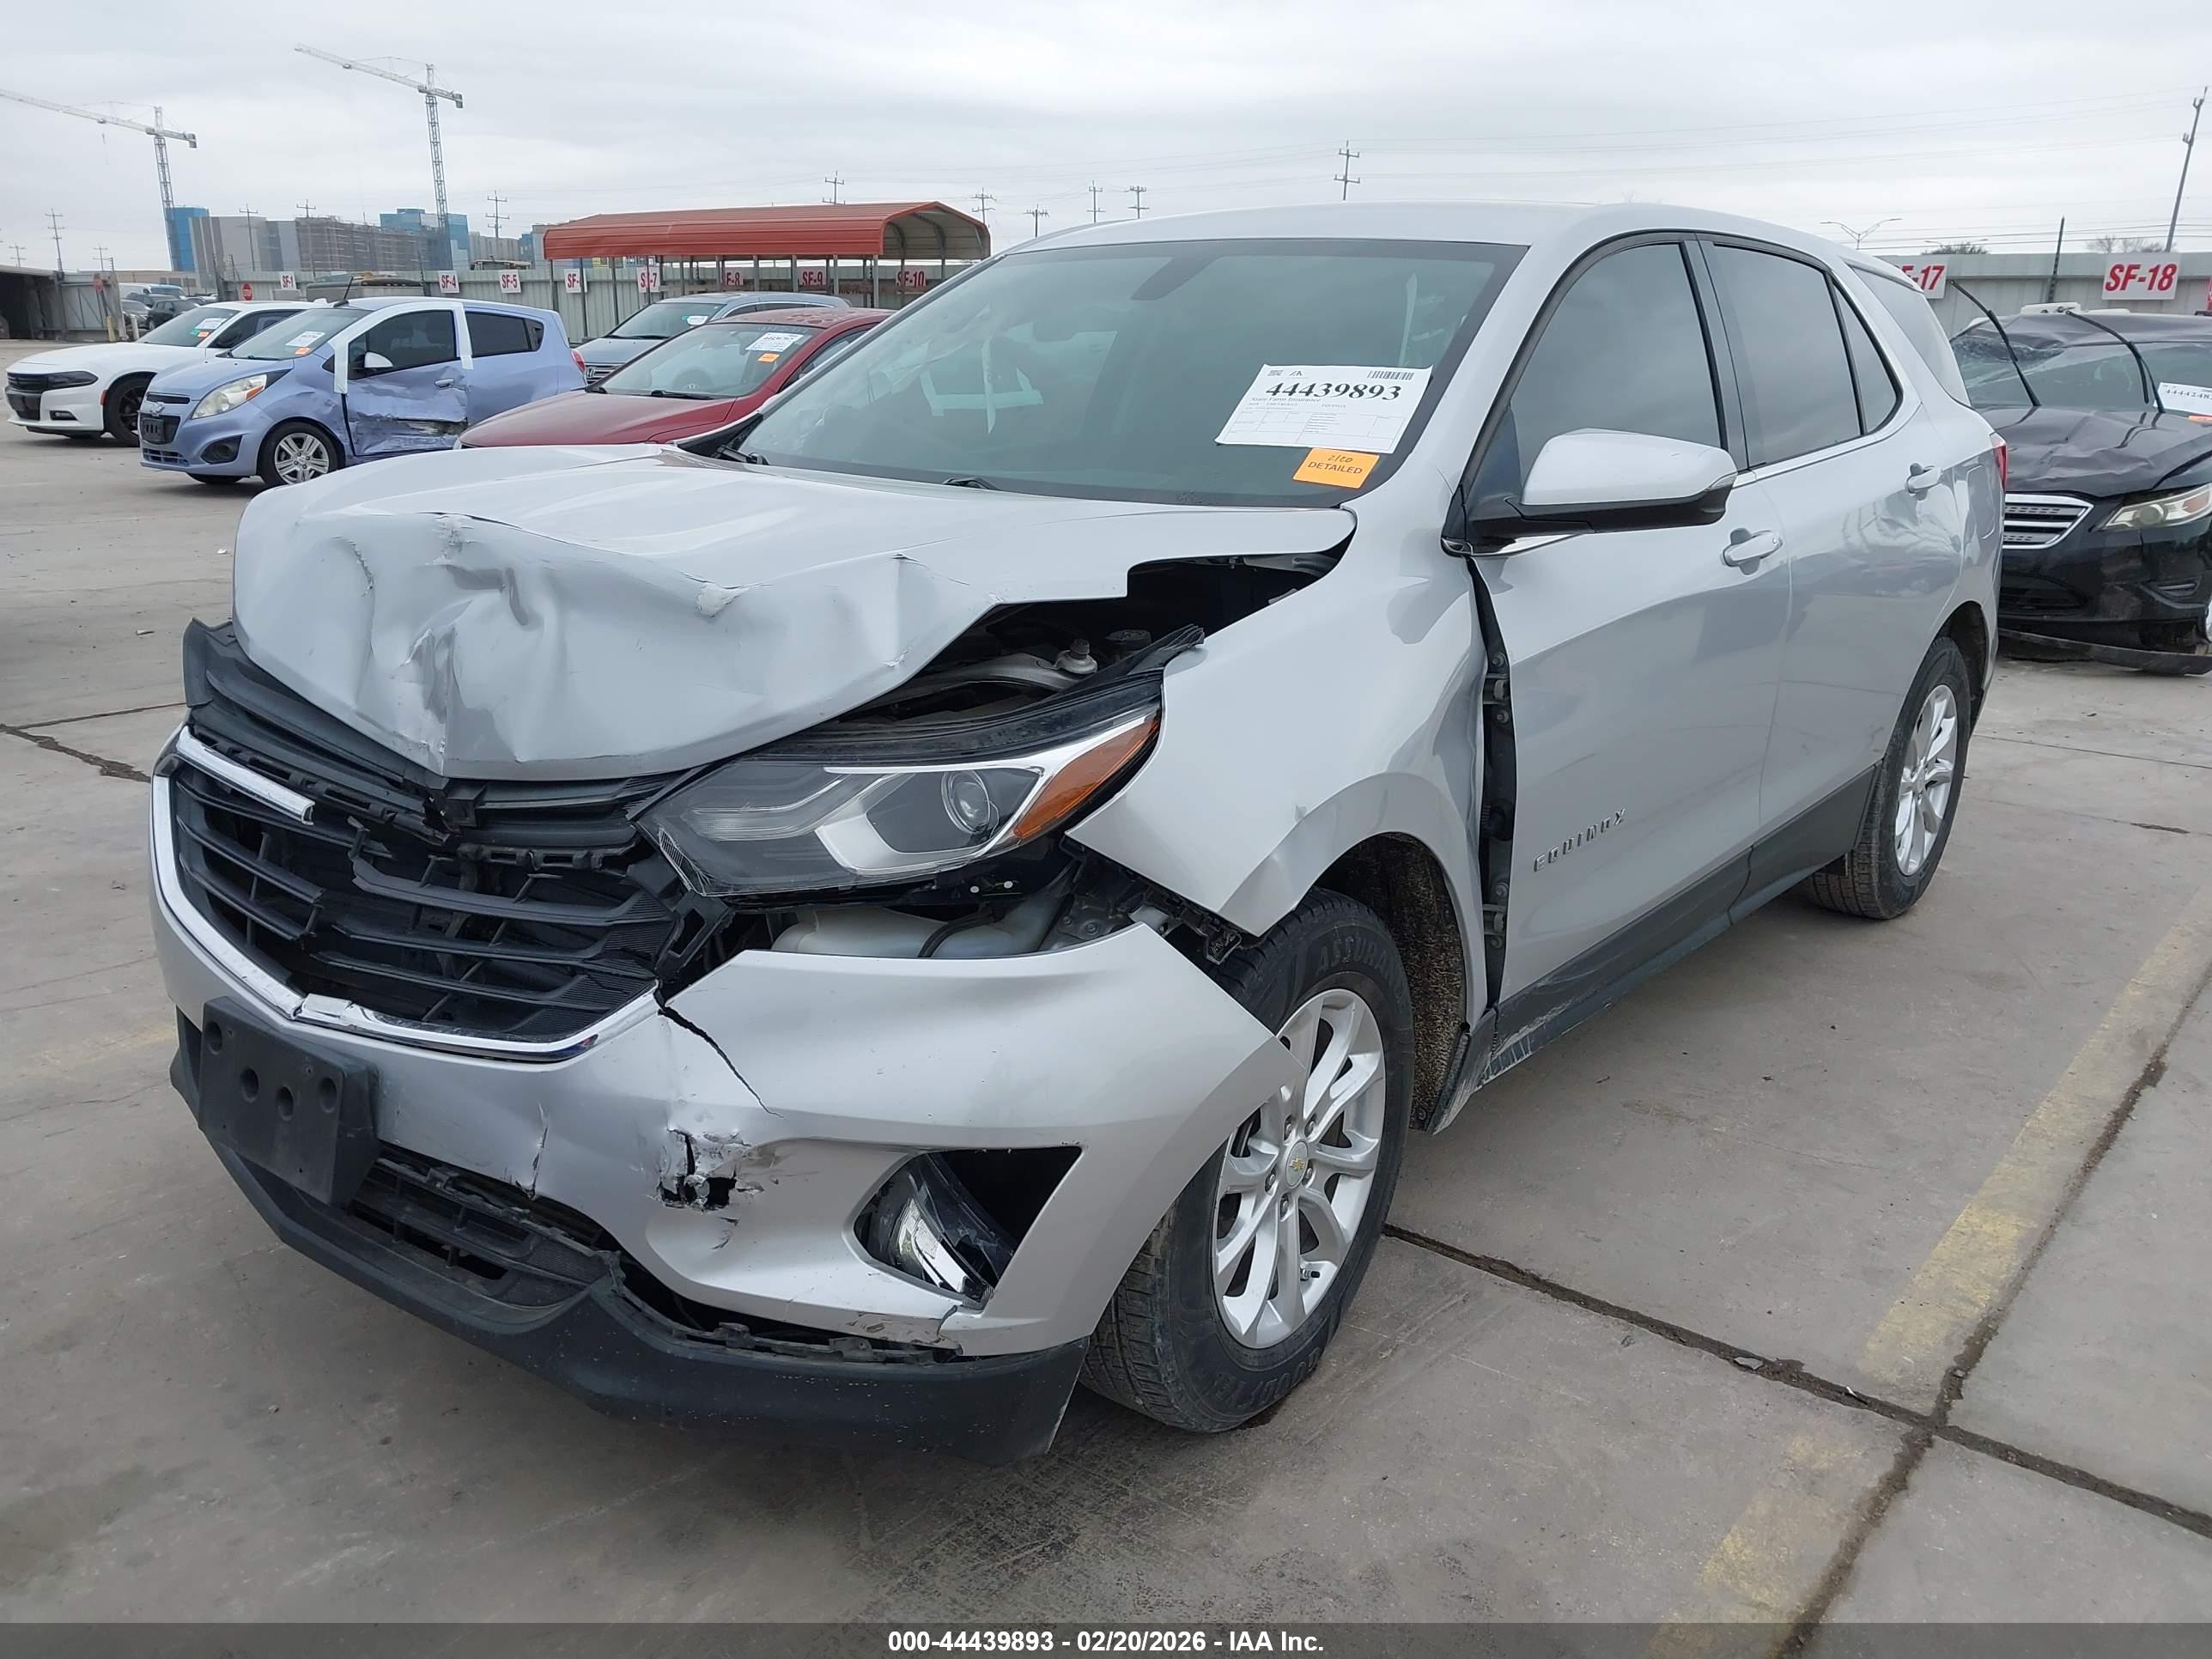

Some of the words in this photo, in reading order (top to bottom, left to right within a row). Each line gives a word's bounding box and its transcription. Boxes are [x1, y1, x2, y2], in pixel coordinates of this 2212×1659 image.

[282, 275, 294, 289] SF-1
[441, 274, 457, 289] SF-4
[501, 274, 518, 289] SF-5
[567, 273, 583, 289] SF-
[641, 272, 658, 288] S-7
[726, 272, 741, 286] F-8
[802, 271, 823, 286] SF-9
[1896, 264, 1945, 290] F-17
[2105, 263, 2178, 291] SF-18
[1266, 382, 1401, 401] 44439893
[1308, 461, 1363, 474] DETAILED
[1534, 808, 1626, 872] EQUINOX
